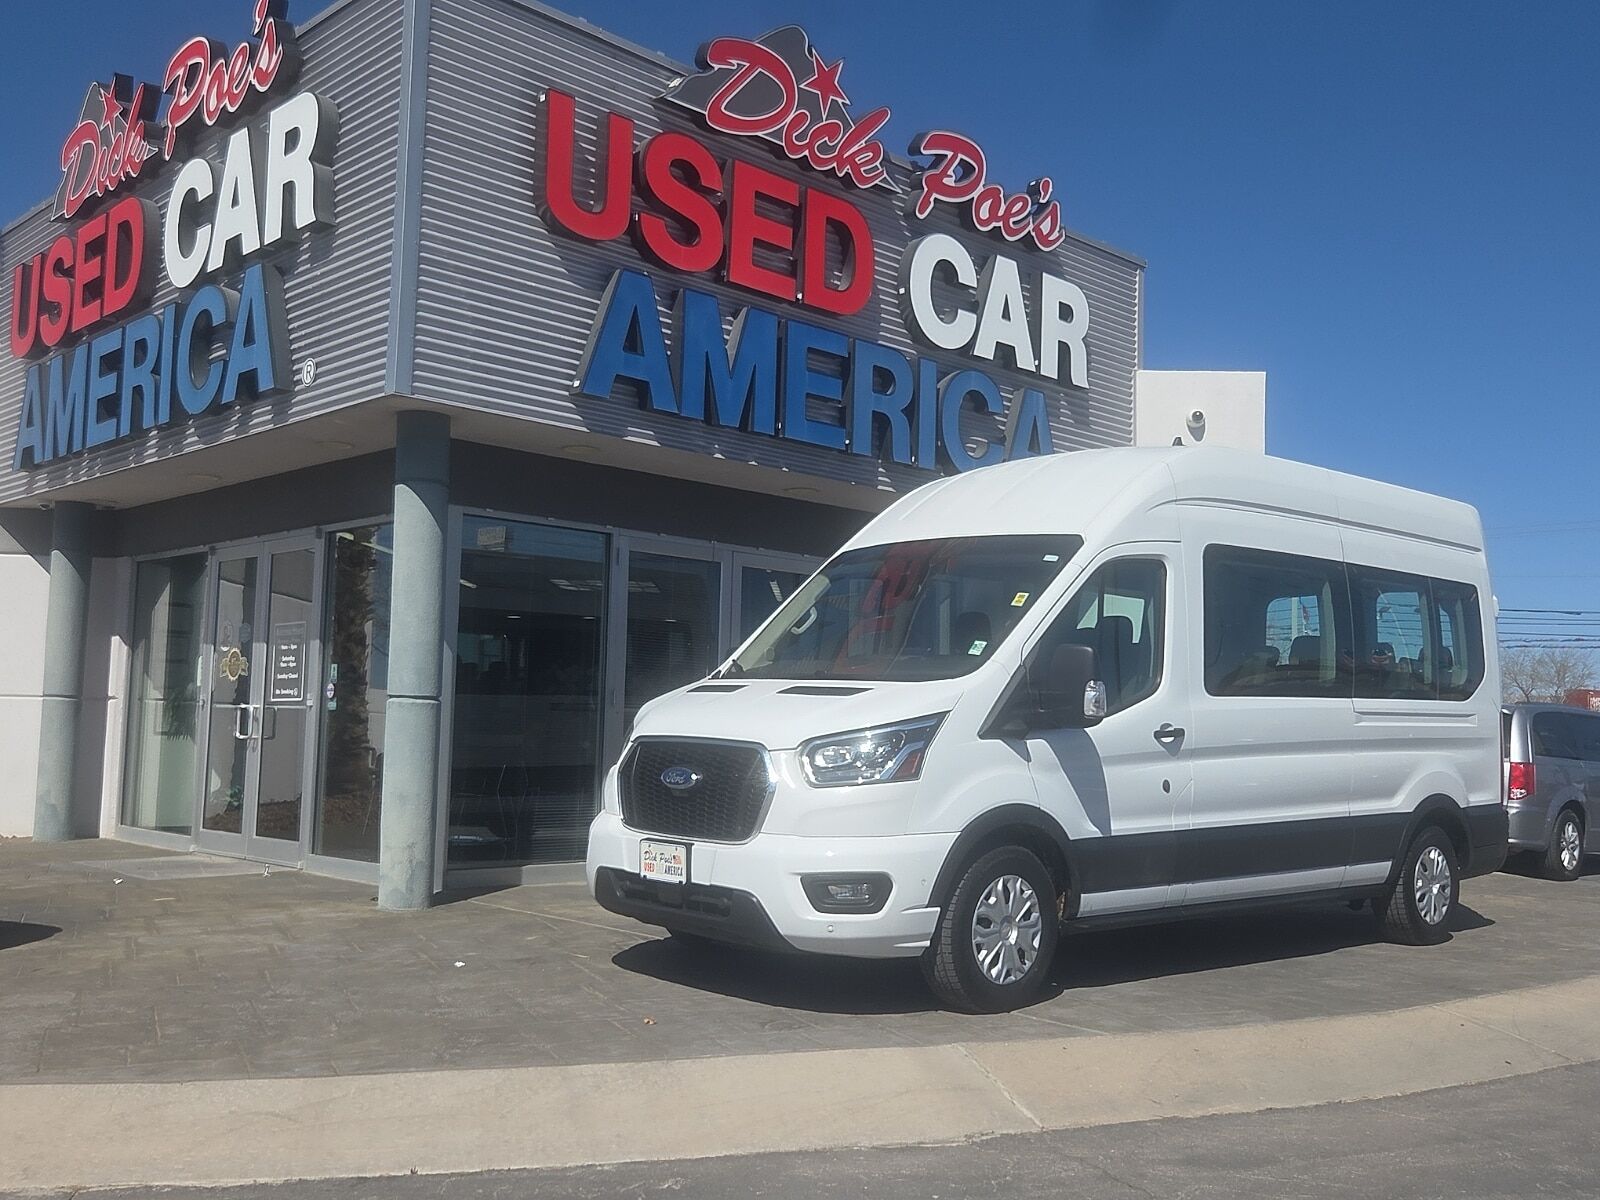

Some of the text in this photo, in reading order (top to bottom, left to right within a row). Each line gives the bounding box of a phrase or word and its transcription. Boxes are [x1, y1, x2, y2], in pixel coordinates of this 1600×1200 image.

[61, 0, 283, 218] Dick Poe's
[705, 37, 1065, 251] Dick Poe's
[11, 92, 319, 358] USED CAR
[544, 88, 1089, 388] USED CAR
[13, 263, 275, 470] AMERICA
[581, 269, 1055, 474] AMERICA
[643, 850, 658, 862] Dick
[643, 861, 655, 872] USED
[664, 864, 683, 877] AMERICA
[666, 771, 688, 784] Ford
